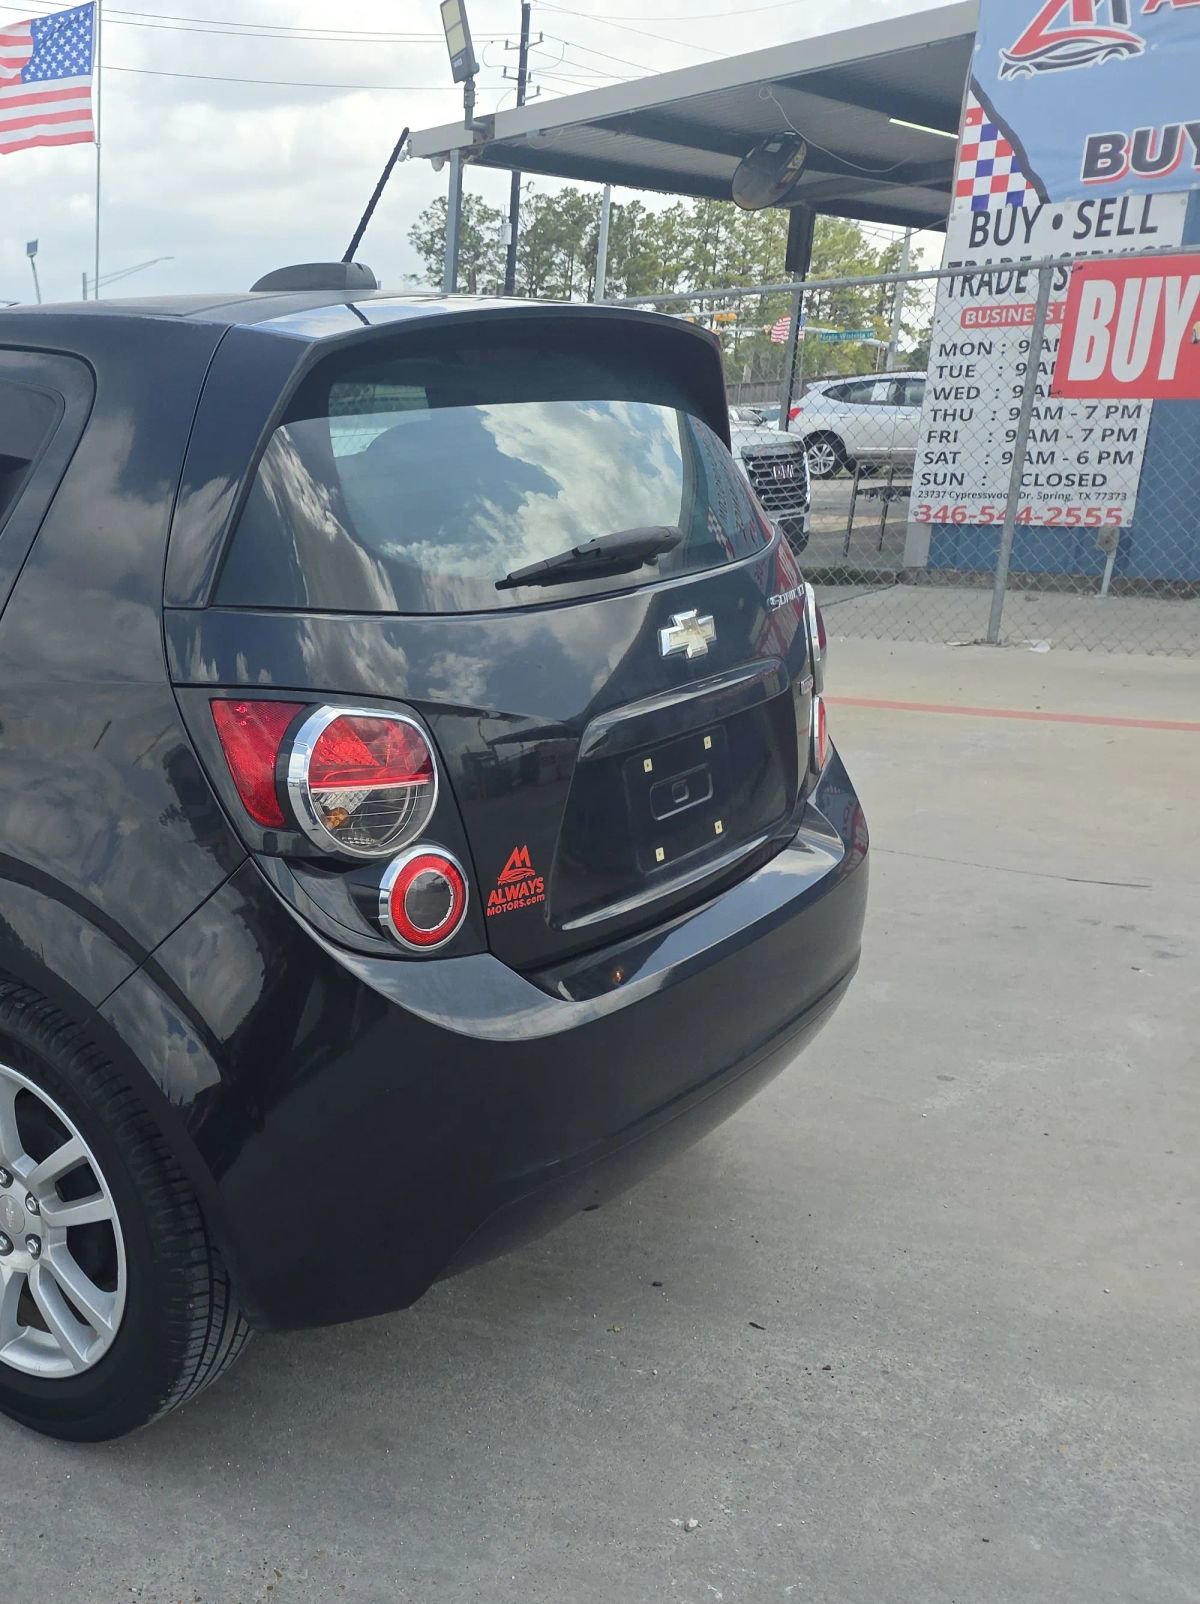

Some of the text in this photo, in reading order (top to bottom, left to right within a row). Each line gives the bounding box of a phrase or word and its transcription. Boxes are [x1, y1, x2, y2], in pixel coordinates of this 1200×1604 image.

[969, 203, 1045, 248] BUY
[1072, 194, 1159, 239] SELL
[947, 256, 1032, 298] TRADE
[965, 306, 1055, 325] BUSINES
[1067, 274, 1200, 383] BUY
[938, 341, 993, 357] MON
[936, 364, 976, 379] TUE
[933, 386, 980, 400] WED
[930, 407, 974, 422] THU
[1085, 405, 1098, 420] 7
[1105, 404, 1142, 419] PM
[927, 430, 959, 443] FRI
[1080, 428, 1094, 442] 7
[1101, 428, 1138, 442] PM
[923, 451, 962, 465] SAT
[1076, 450, 1089, 465] 6
[1097, 450, 1134, 465] PM
[920, 472, 965, 486] SUN
[1020, 473, 1107, 487] CLOSED
[918, 490, 946, 499] 23737
[949, 490, 1009, 501] Cypresswoo
[1078, 491, 1092, 500] TX
[1094, 492, 1127, 501] 77373
[488, 877, 545, 907] ALWAYS
